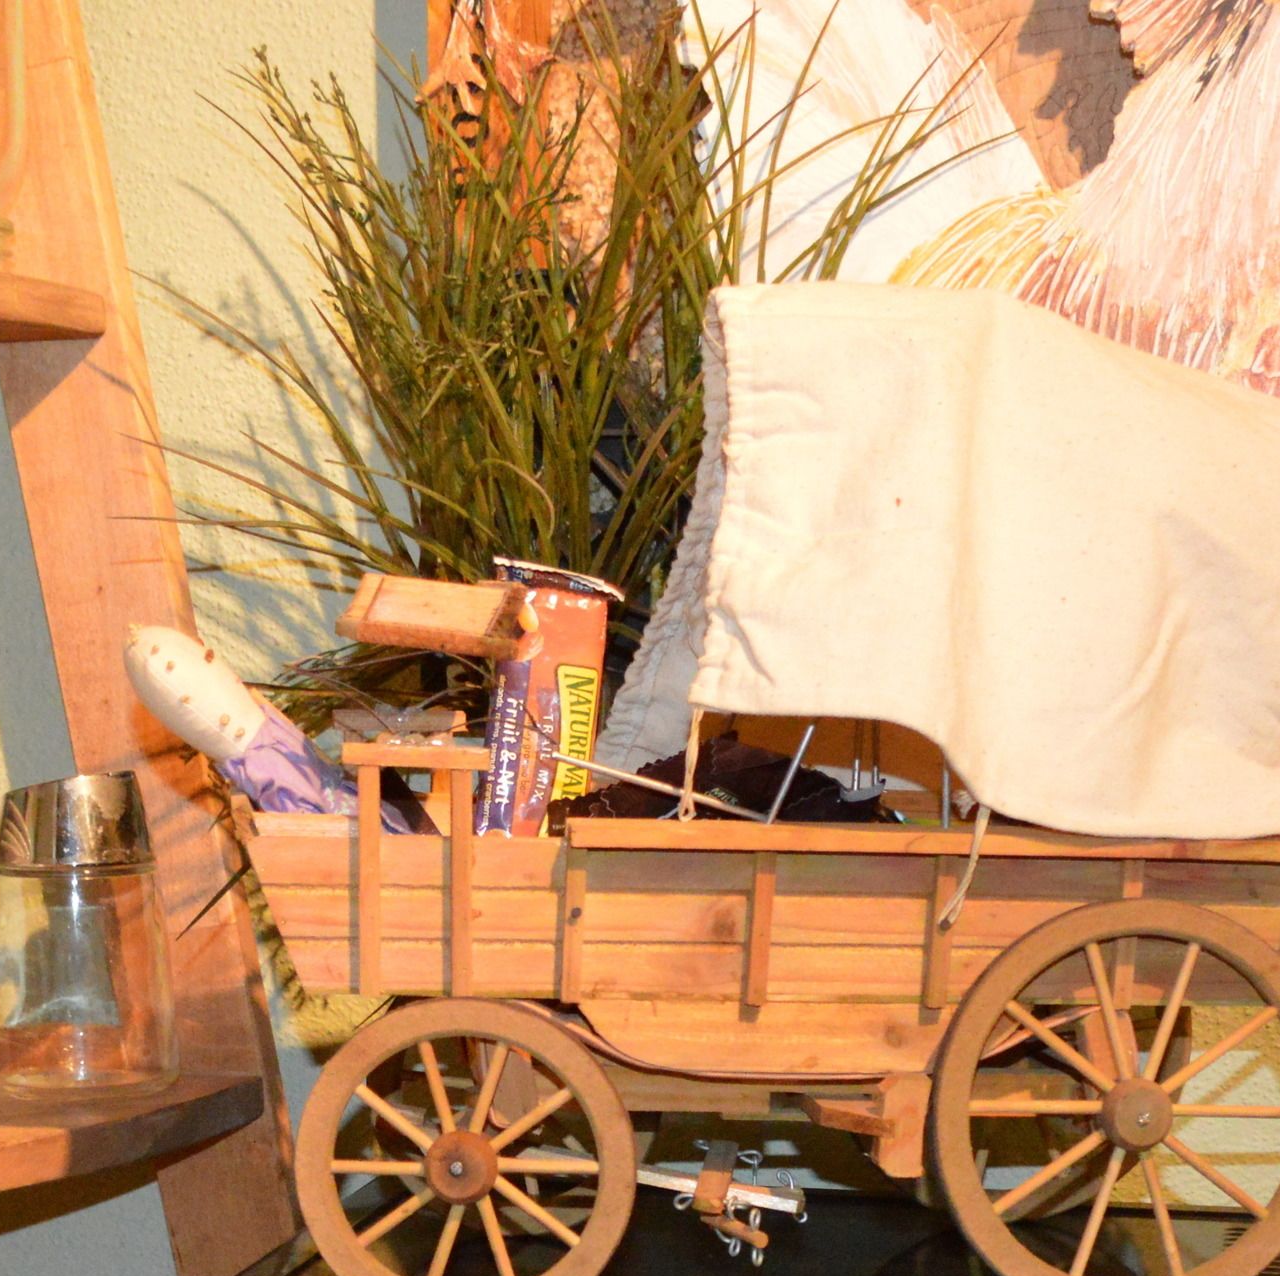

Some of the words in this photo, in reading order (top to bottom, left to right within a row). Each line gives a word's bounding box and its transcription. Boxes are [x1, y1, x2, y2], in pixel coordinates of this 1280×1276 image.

[502, 697, 524, 744] Fruit
[539, 713, 554, 760] TRAIL
[500, 748, 517, 764] &
[494, 769, 515, 805] Nut
[534, 769, 549, 800] MIX
